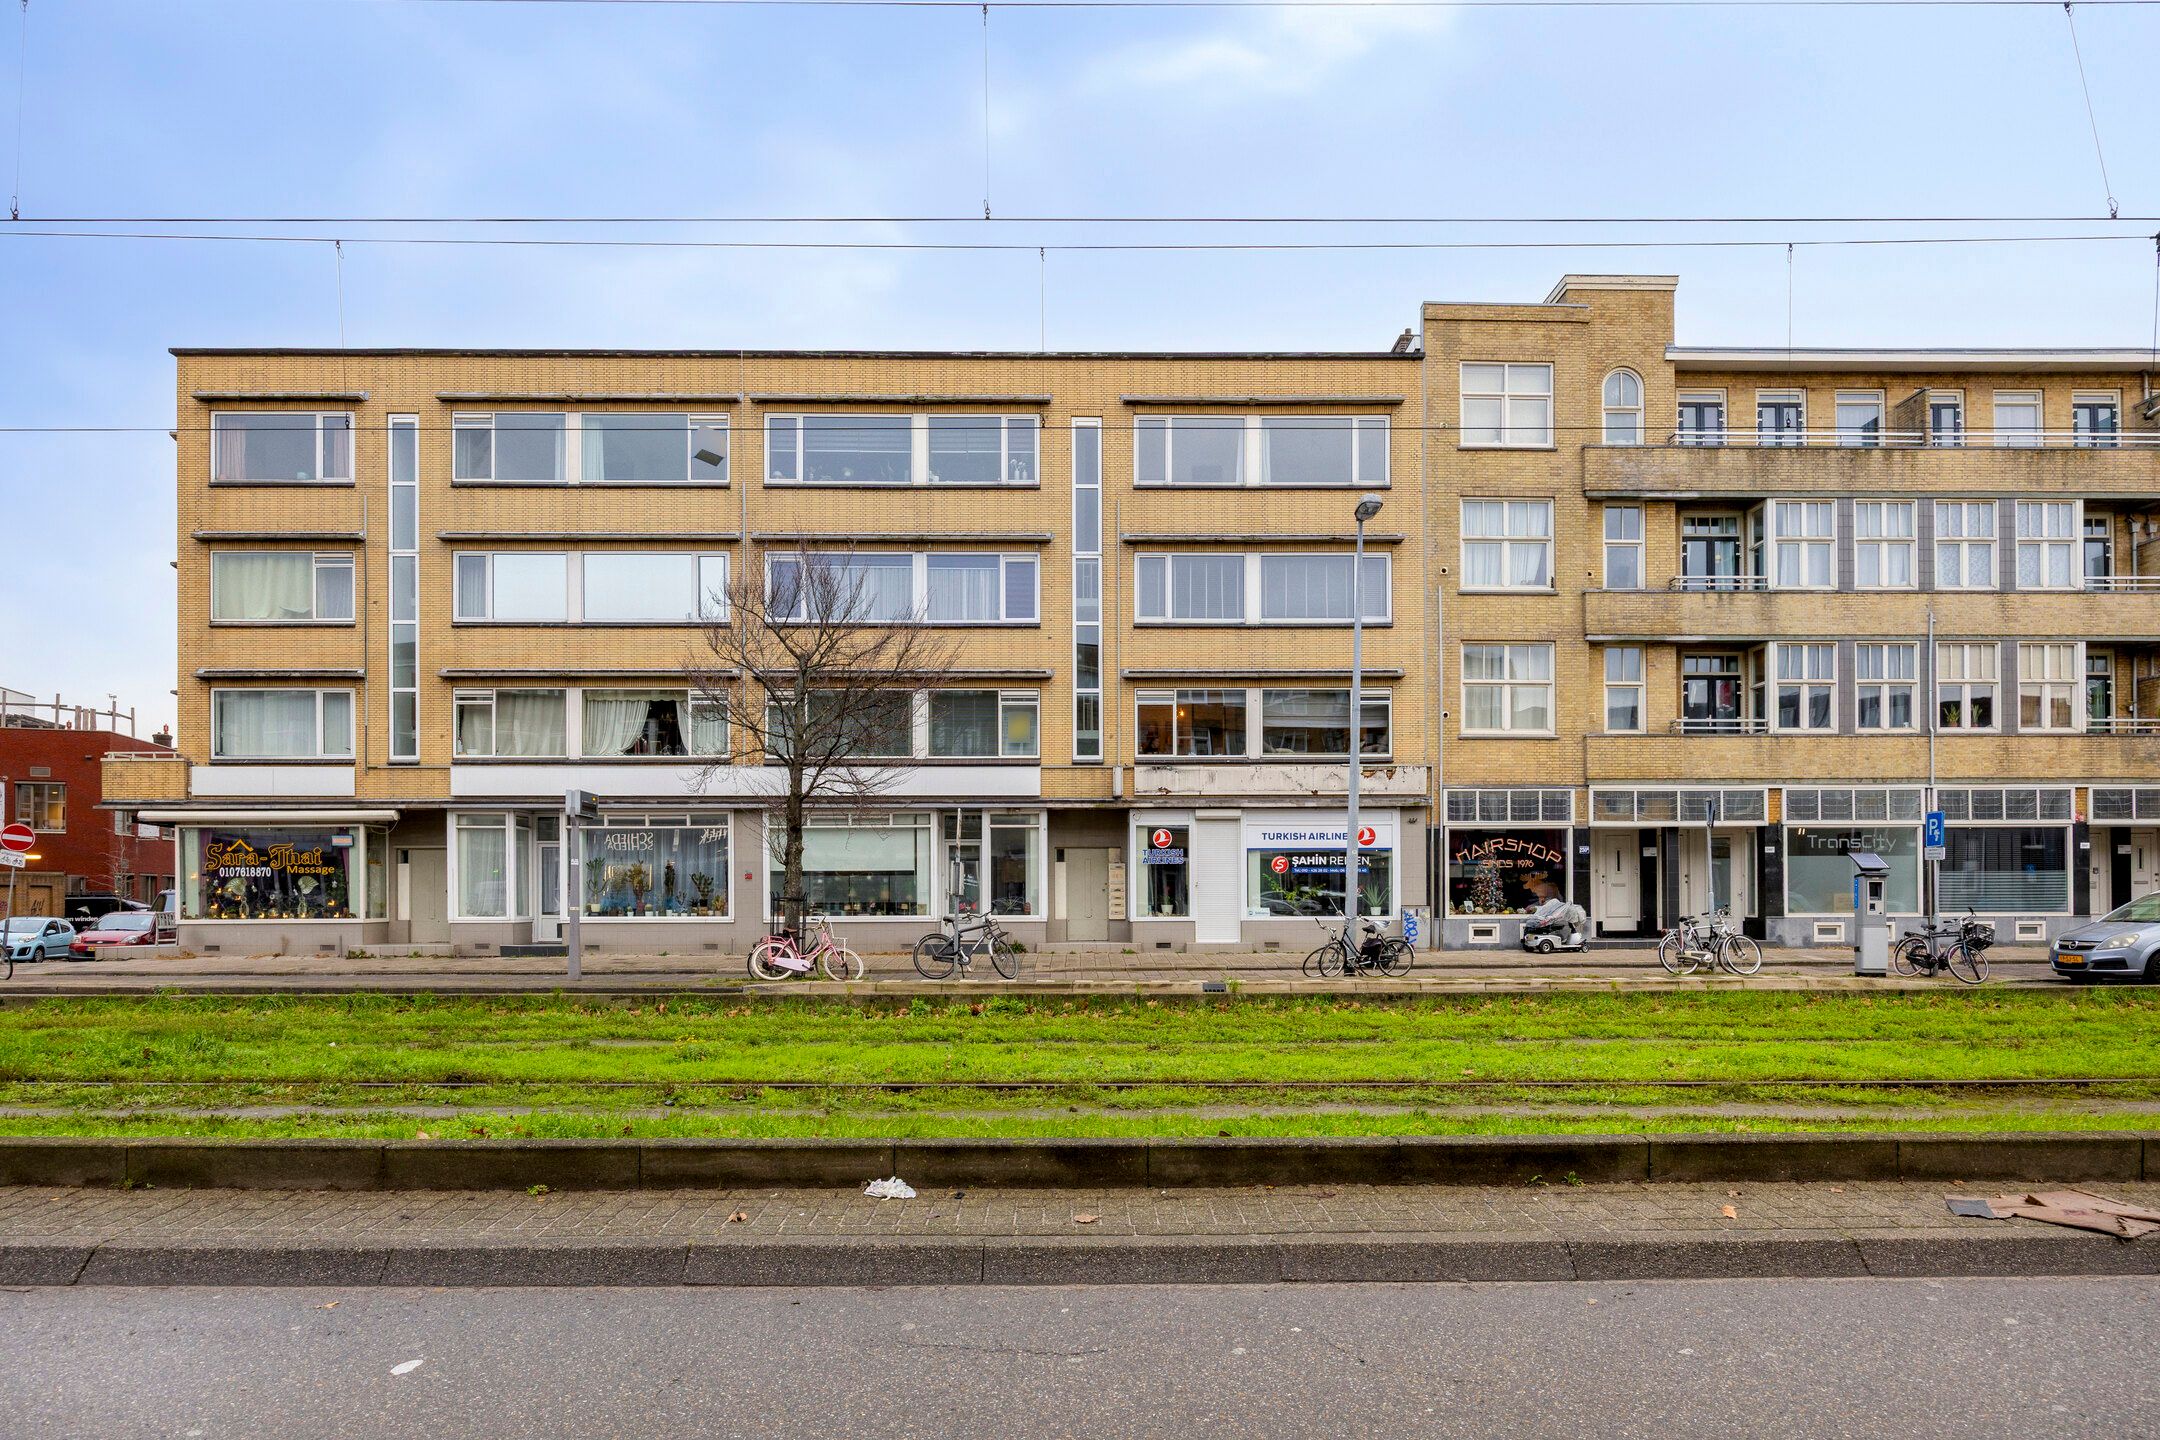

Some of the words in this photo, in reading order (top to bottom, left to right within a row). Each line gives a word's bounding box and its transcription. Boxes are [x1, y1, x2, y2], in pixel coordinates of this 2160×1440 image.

[1929, 818, 1938, 836] P
[1262, 832, 1306, 841] TURKISH
[1308, 832, 1347, 841] AIRLINE
[1807, 834, 1897, 853] TransCity
[205, 842, 322, 870] Sara-Thai
[1142, 848, 1184, 857] TURKISH
[1455, 838, 1562, 864] HAIRSHOP
[1142, 857, 1184, 865] AIRLINES
[1517, 859, 1534, 868] 1976
[219, 866, 271, 877] 0107618870
[287, 865, 335, 875] Massage
